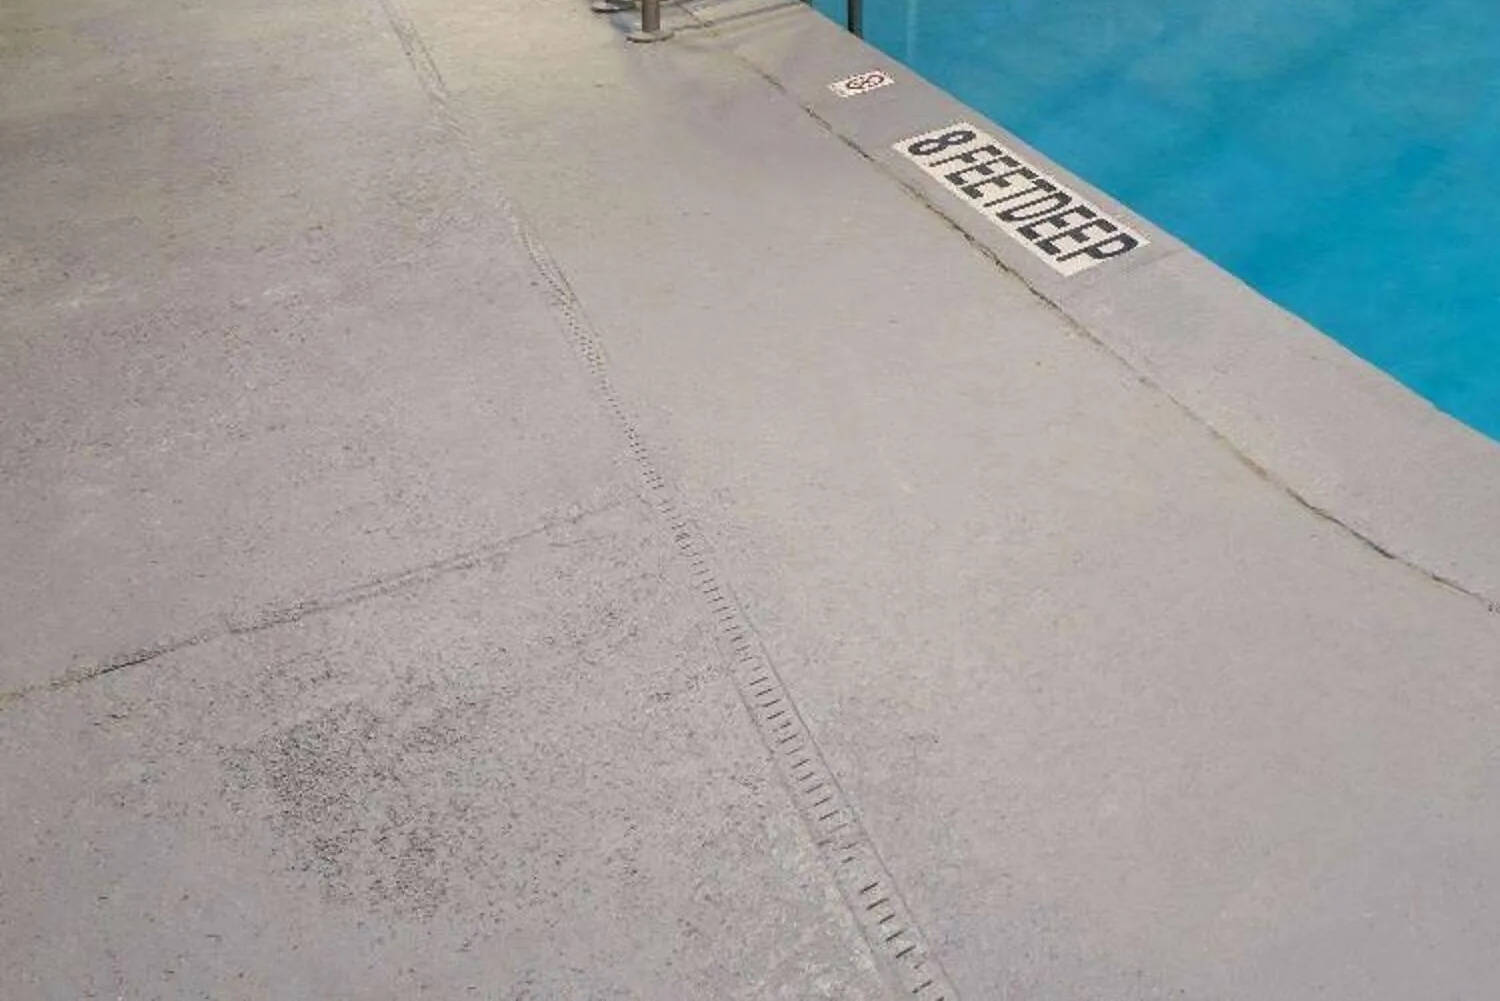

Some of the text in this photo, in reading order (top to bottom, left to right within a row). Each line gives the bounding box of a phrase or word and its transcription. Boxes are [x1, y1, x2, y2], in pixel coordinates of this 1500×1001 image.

[907, 129, 1140, 262] 8 FEET DEEP
